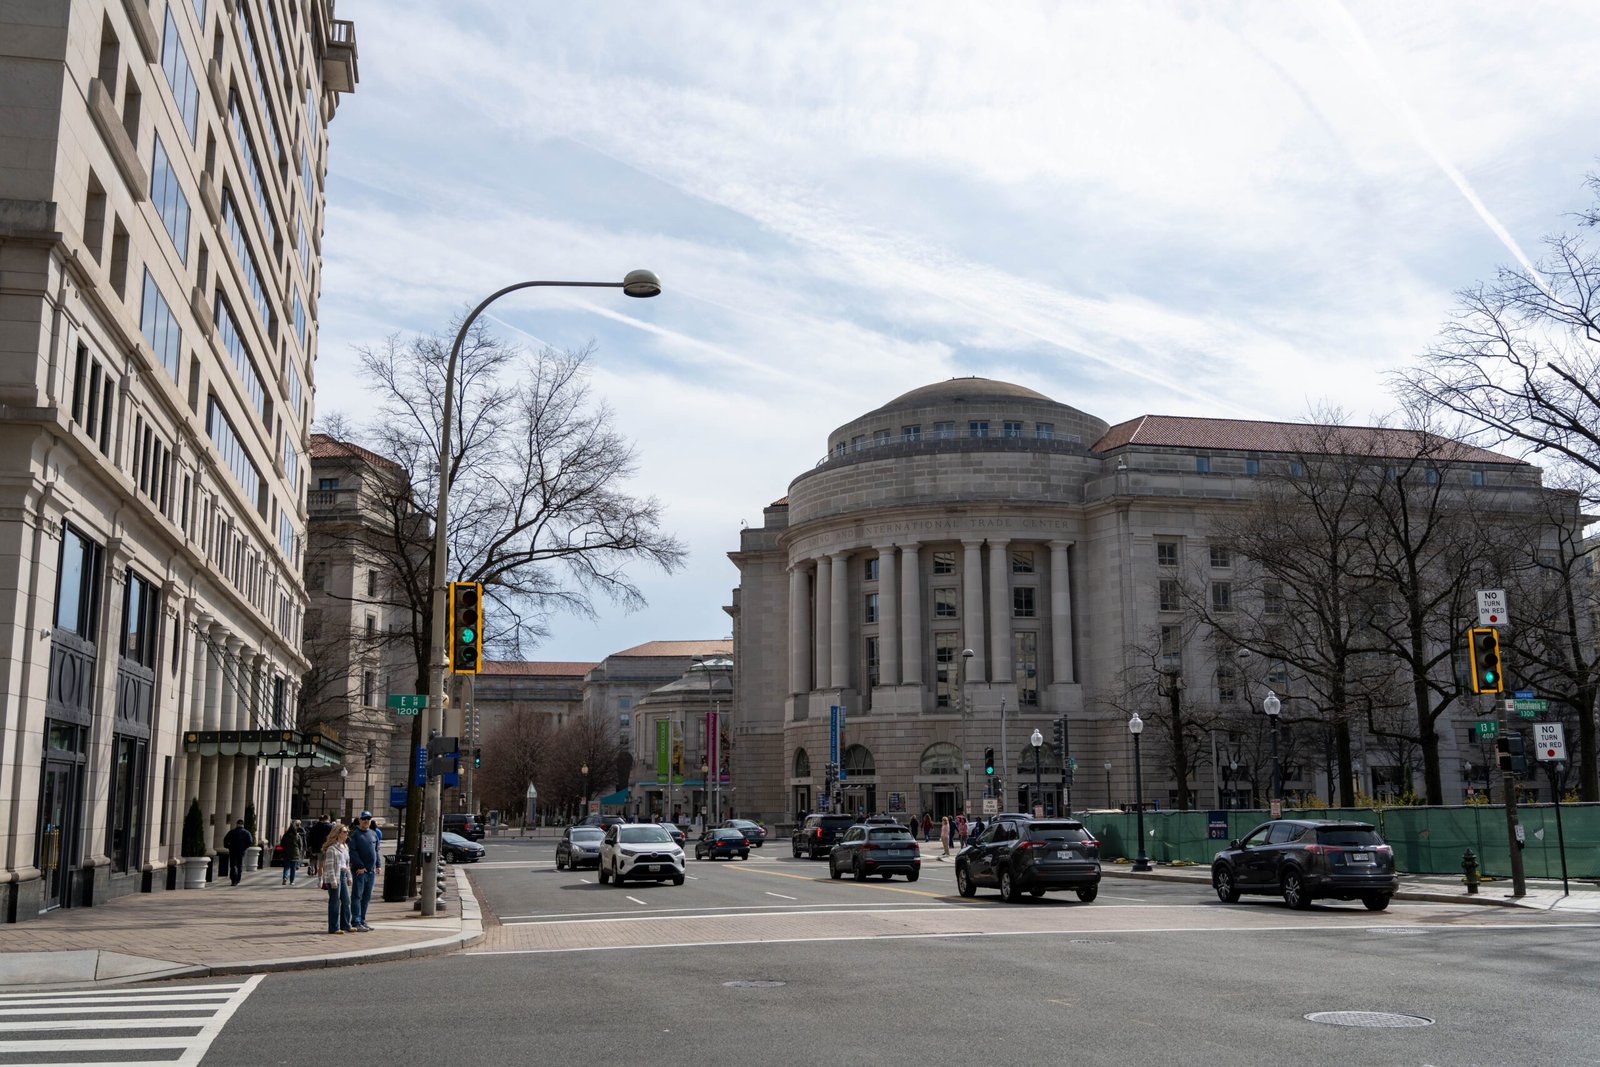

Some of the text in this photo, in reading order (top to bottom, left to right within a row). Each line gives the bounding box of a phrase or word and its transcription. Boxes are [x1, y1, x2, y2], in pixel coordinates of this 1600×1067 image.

[861, 520, 958, 536] INTERNATIONAL
[970, 519, 1012, 528] TRADE
[1022, 519, 1069, 529] CENTER
[401, 696, 407, 706] E
[1514, 700, 1541, 710] Pennsylvania
[1480, 723, 1488, 732] 13
